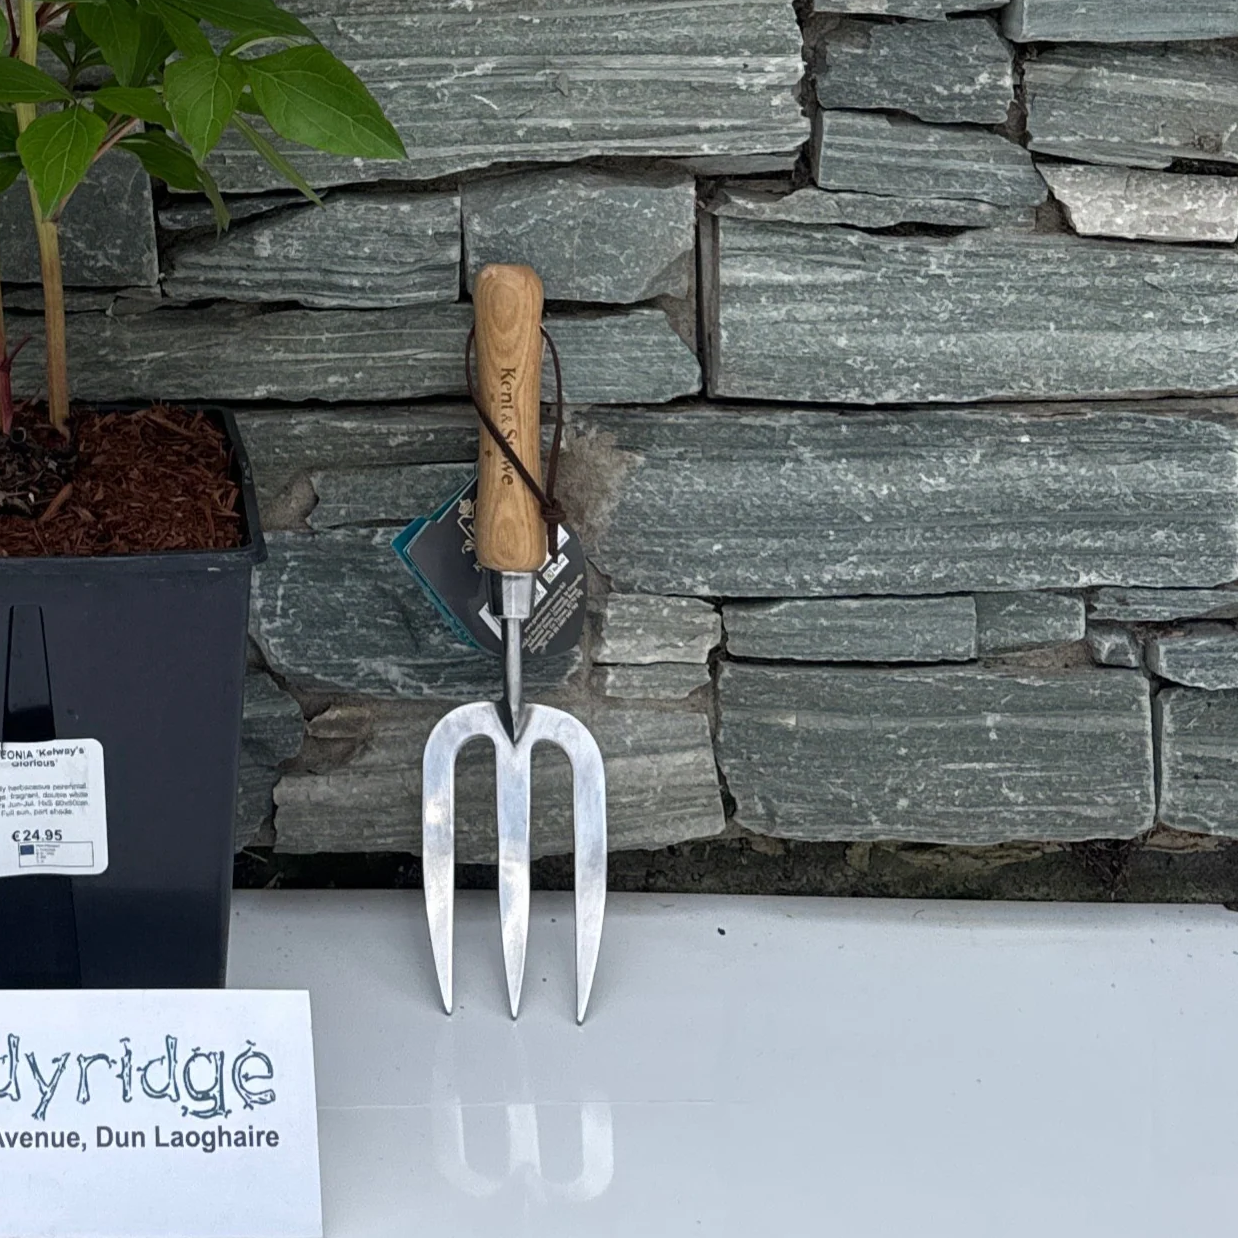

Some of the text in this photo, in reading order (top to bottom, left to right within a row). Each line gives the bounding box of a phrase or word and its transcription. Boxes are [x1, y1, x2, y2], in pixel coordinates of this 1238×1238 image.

[500, 367, 517, 486] Kent & Swe
[12, 829, 63, 842] €24.95
[96, 1125, 146, 1149] Dun
[155, 1125, 280, 1153] Laoghaire
